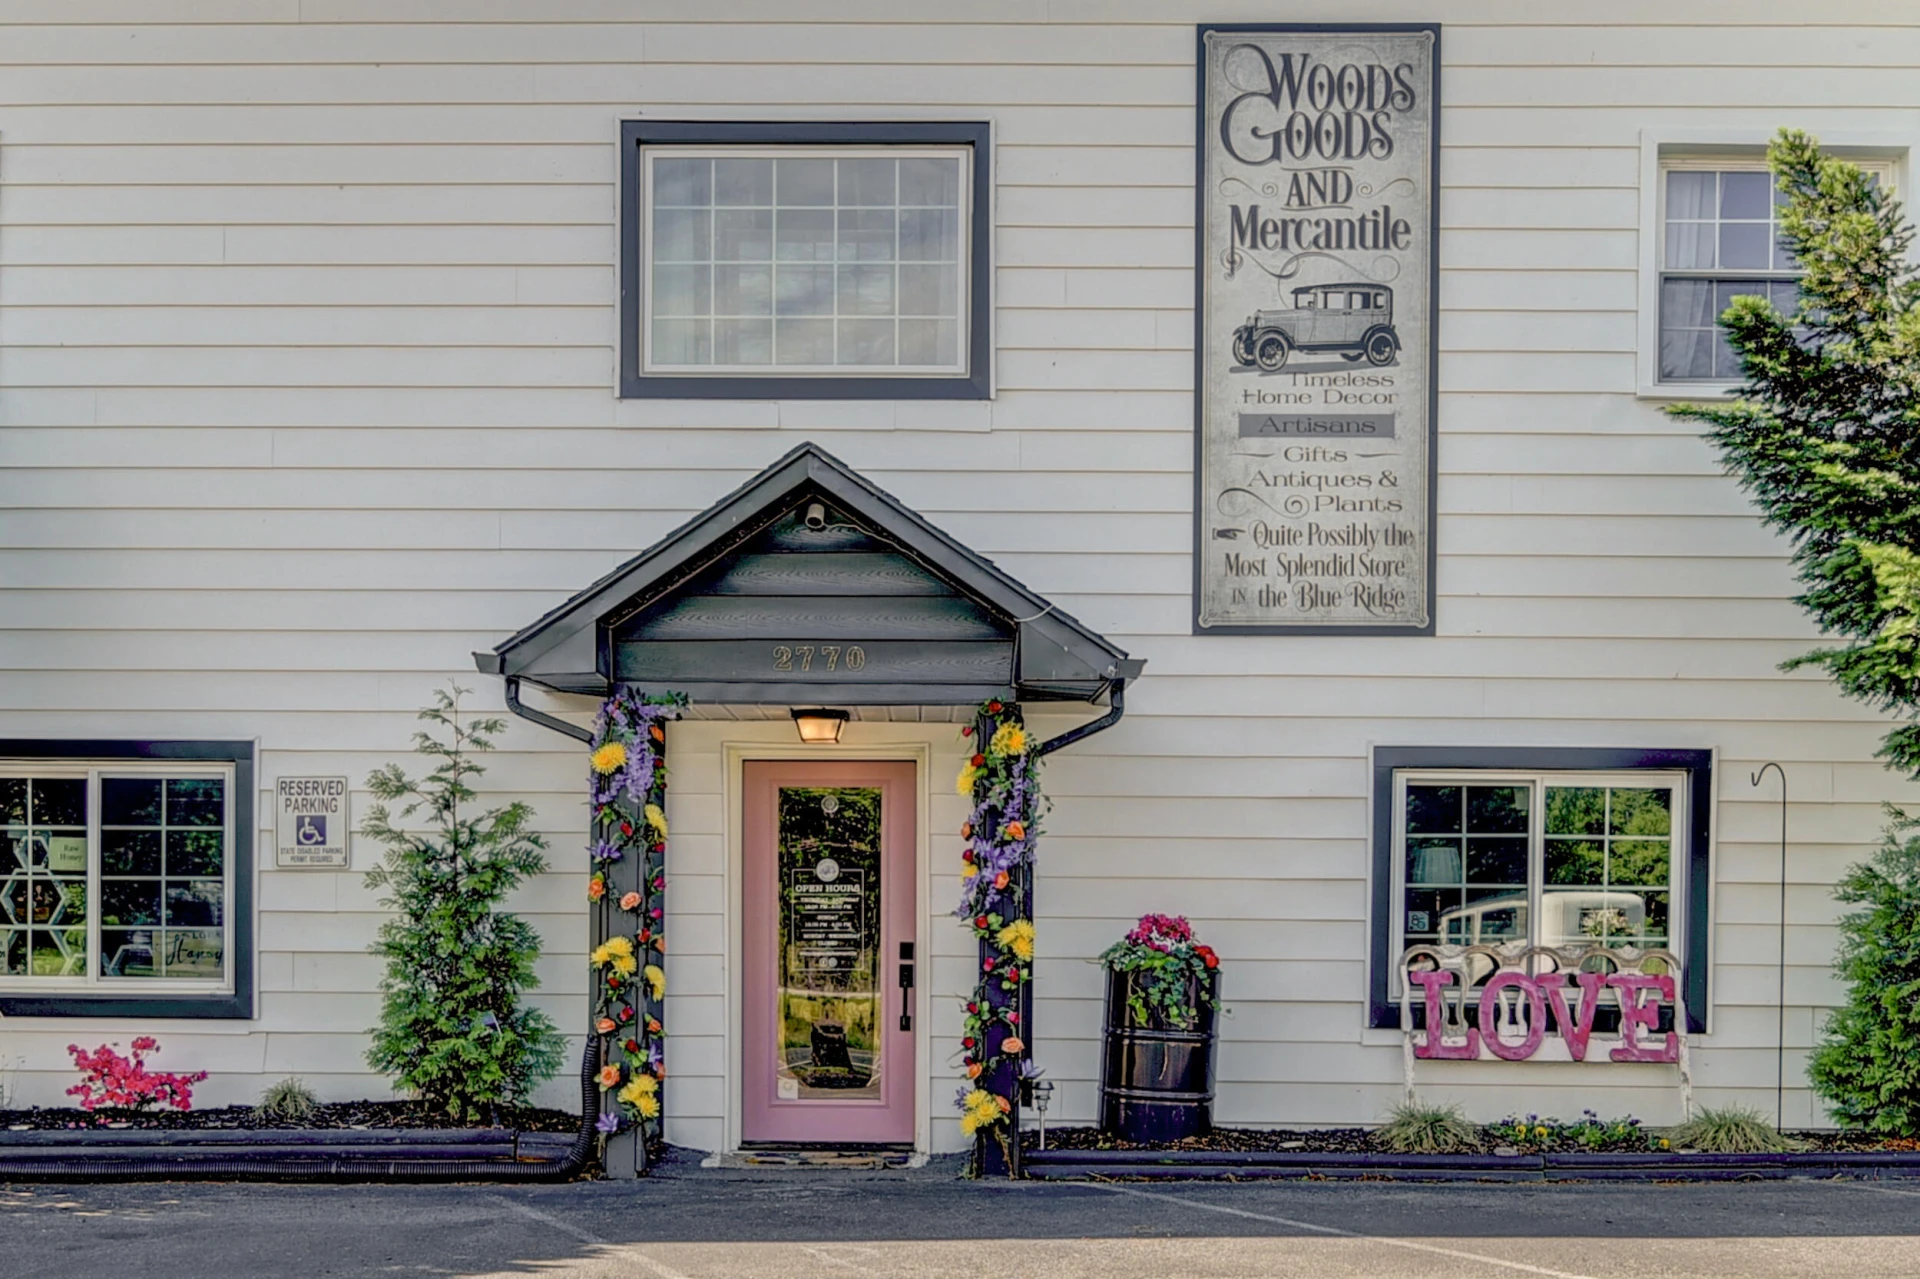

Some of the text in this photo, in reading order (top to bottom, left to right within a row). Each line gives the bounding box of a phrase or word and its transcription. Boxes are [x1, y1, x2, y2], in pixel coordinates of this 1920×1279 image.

[1285, 170, 1353, 206] AND
[1226, 204, 1412, 270] Mercantile
[1287, 372, 1394, 387] Timeless
[1241, 389, 1399, 405] Home Decor
[1258, 416, 1376, 433] Artisans
[1283, 446, 1348, 462] Gifts
[1248, 470, 1398, 491] Antiques &
[1314, 495, 1403, 512] Plants
[1251, 520, 1413, 551] Quite Possibly the
[1224, 551, 1405, 583] Most Splendid Store
[1258, 584, 1287, 608] the
[1292, 580, 1342, 612] Blue
[1344, 581, 1405, 617] Ridge
[773, 646, 865, 671] 2770
[279, 781, 344, 796] RESERVED
[284, 797, 338, 813] PARKING
[795, 884, 860, 893] OPEN HOURS
[1410, 969, 1679, 1062] LOVE
